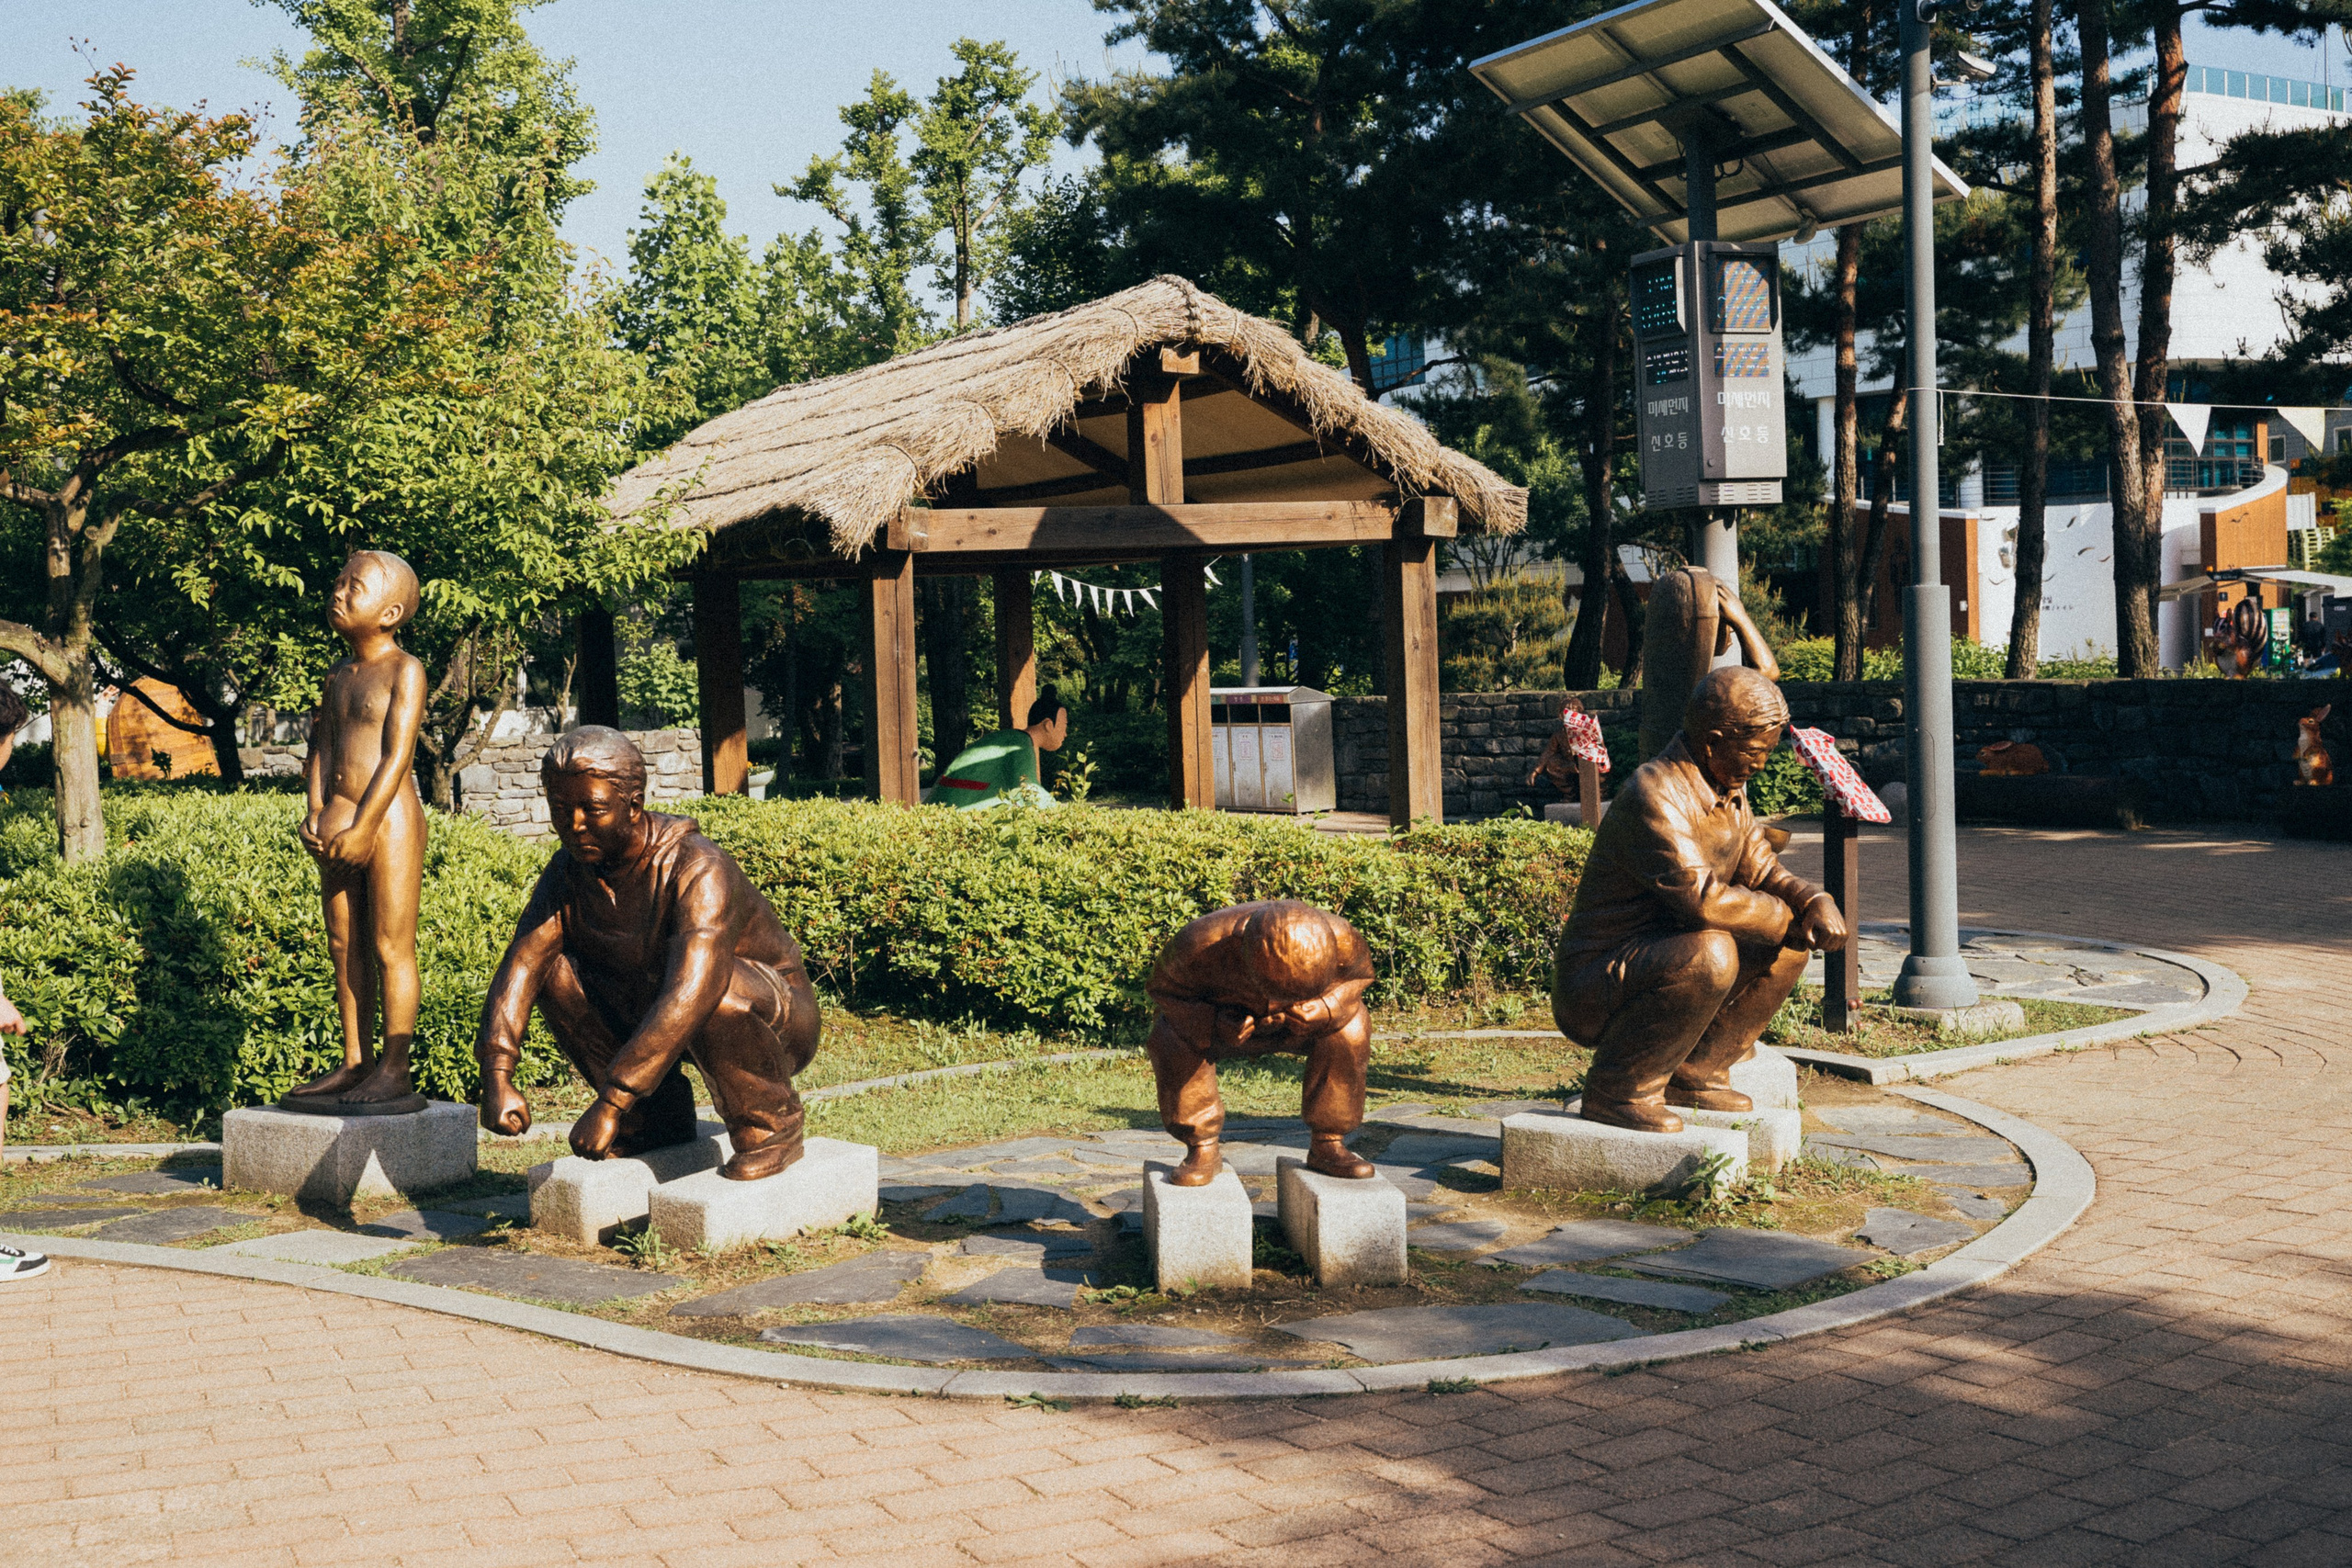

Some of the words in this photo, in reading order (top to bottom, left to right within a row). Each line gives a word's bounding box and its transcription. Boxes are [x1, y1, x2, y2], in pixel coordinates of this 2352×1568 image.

[1647, 397, 1688, 417] 미세먼지
[1717, 391, 1770, 409] 미세먼지
[1651, 432, 1688, 452] 신호등
[1721, 425, 1769, 444] 신호등
